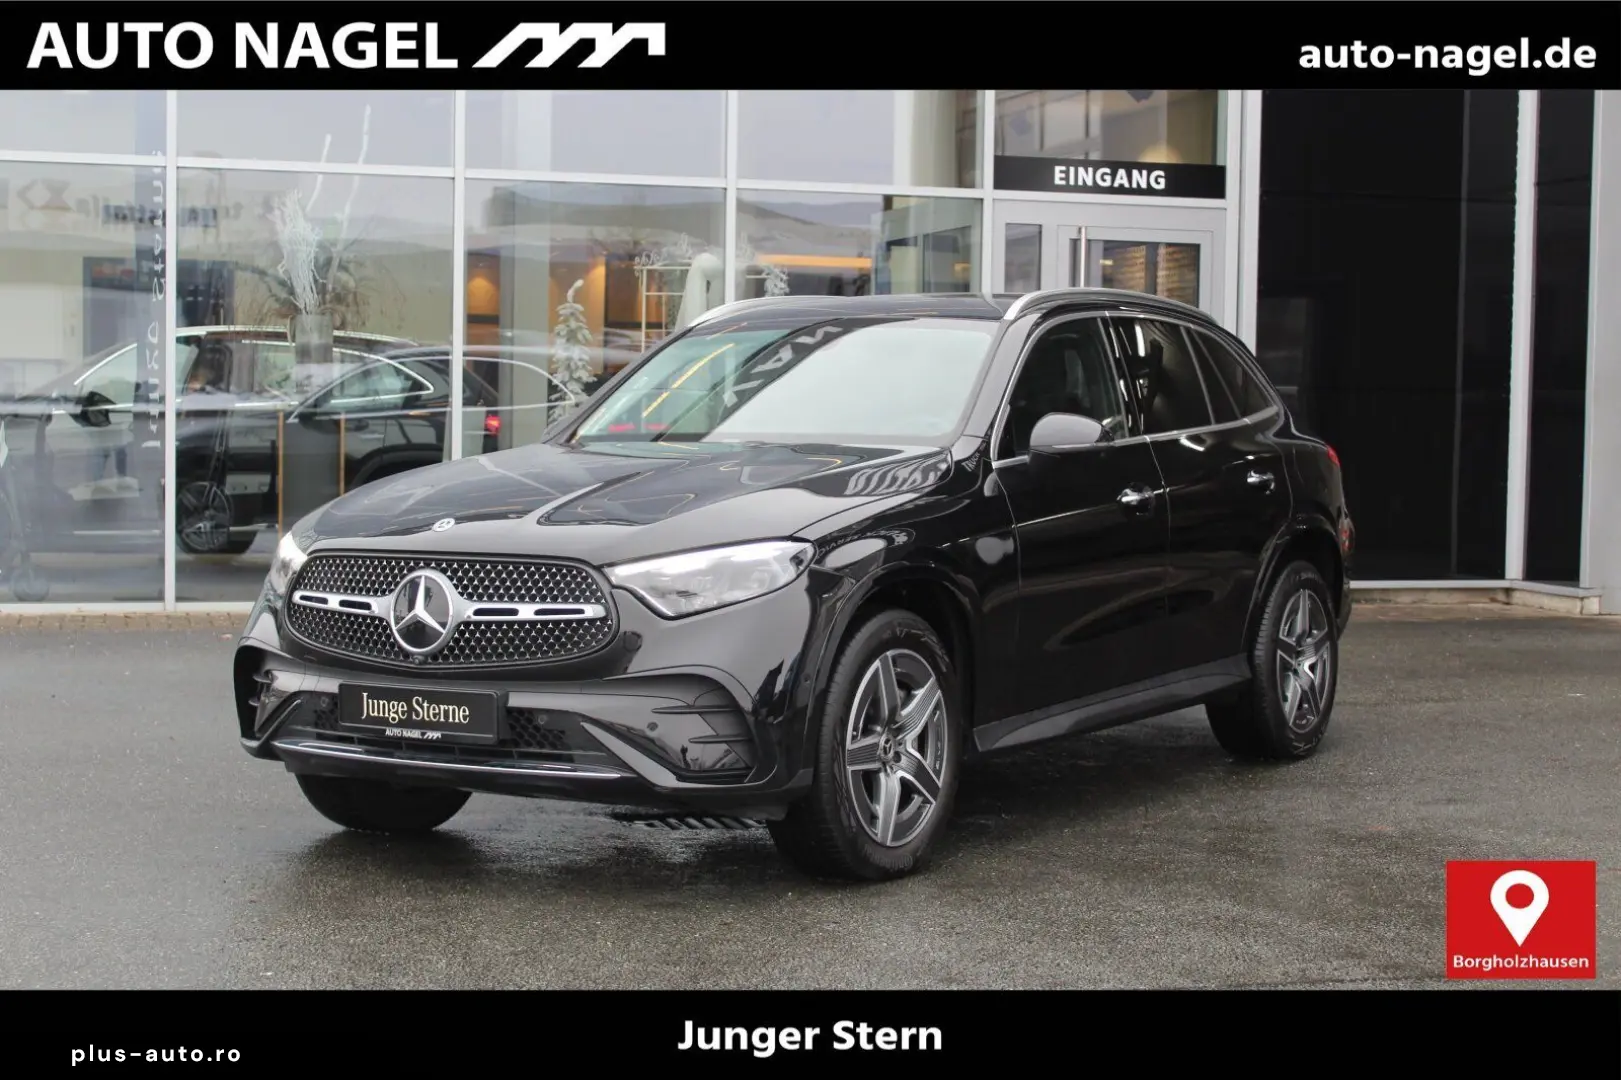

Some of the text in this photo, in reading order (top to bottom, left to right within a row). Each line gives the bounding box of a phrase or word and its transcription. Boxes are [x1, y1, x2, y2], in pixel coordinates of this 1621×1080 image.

[1053, 165, 1167, 190] EINGANG
[361, 692, 470, 724] Junge Sterne
[385, 728, 402, 737] AUTO
